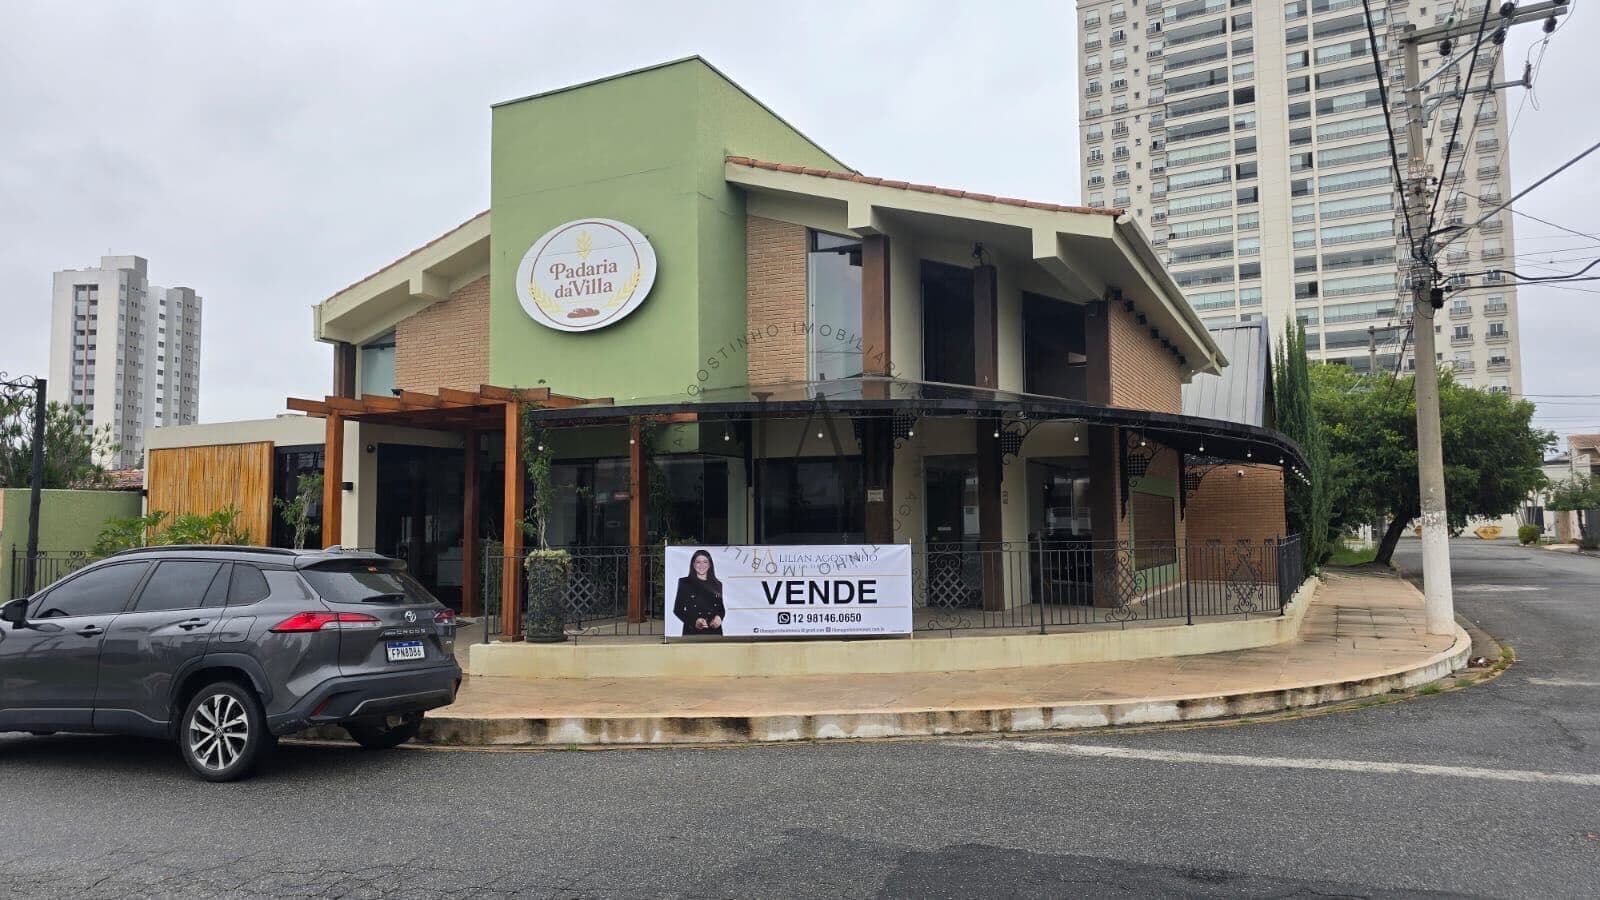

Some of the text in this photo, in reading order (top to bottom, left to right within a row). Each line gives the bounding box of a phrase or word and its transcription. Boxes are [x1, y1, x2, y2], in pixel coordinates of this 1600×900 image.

[550, 259, 618, 280] Padaria
[779, 554, 812, 563] LILIAN
[762, 580, 877, 605] VENDE
[792, 612, 862, 624] 12 98146.0650
